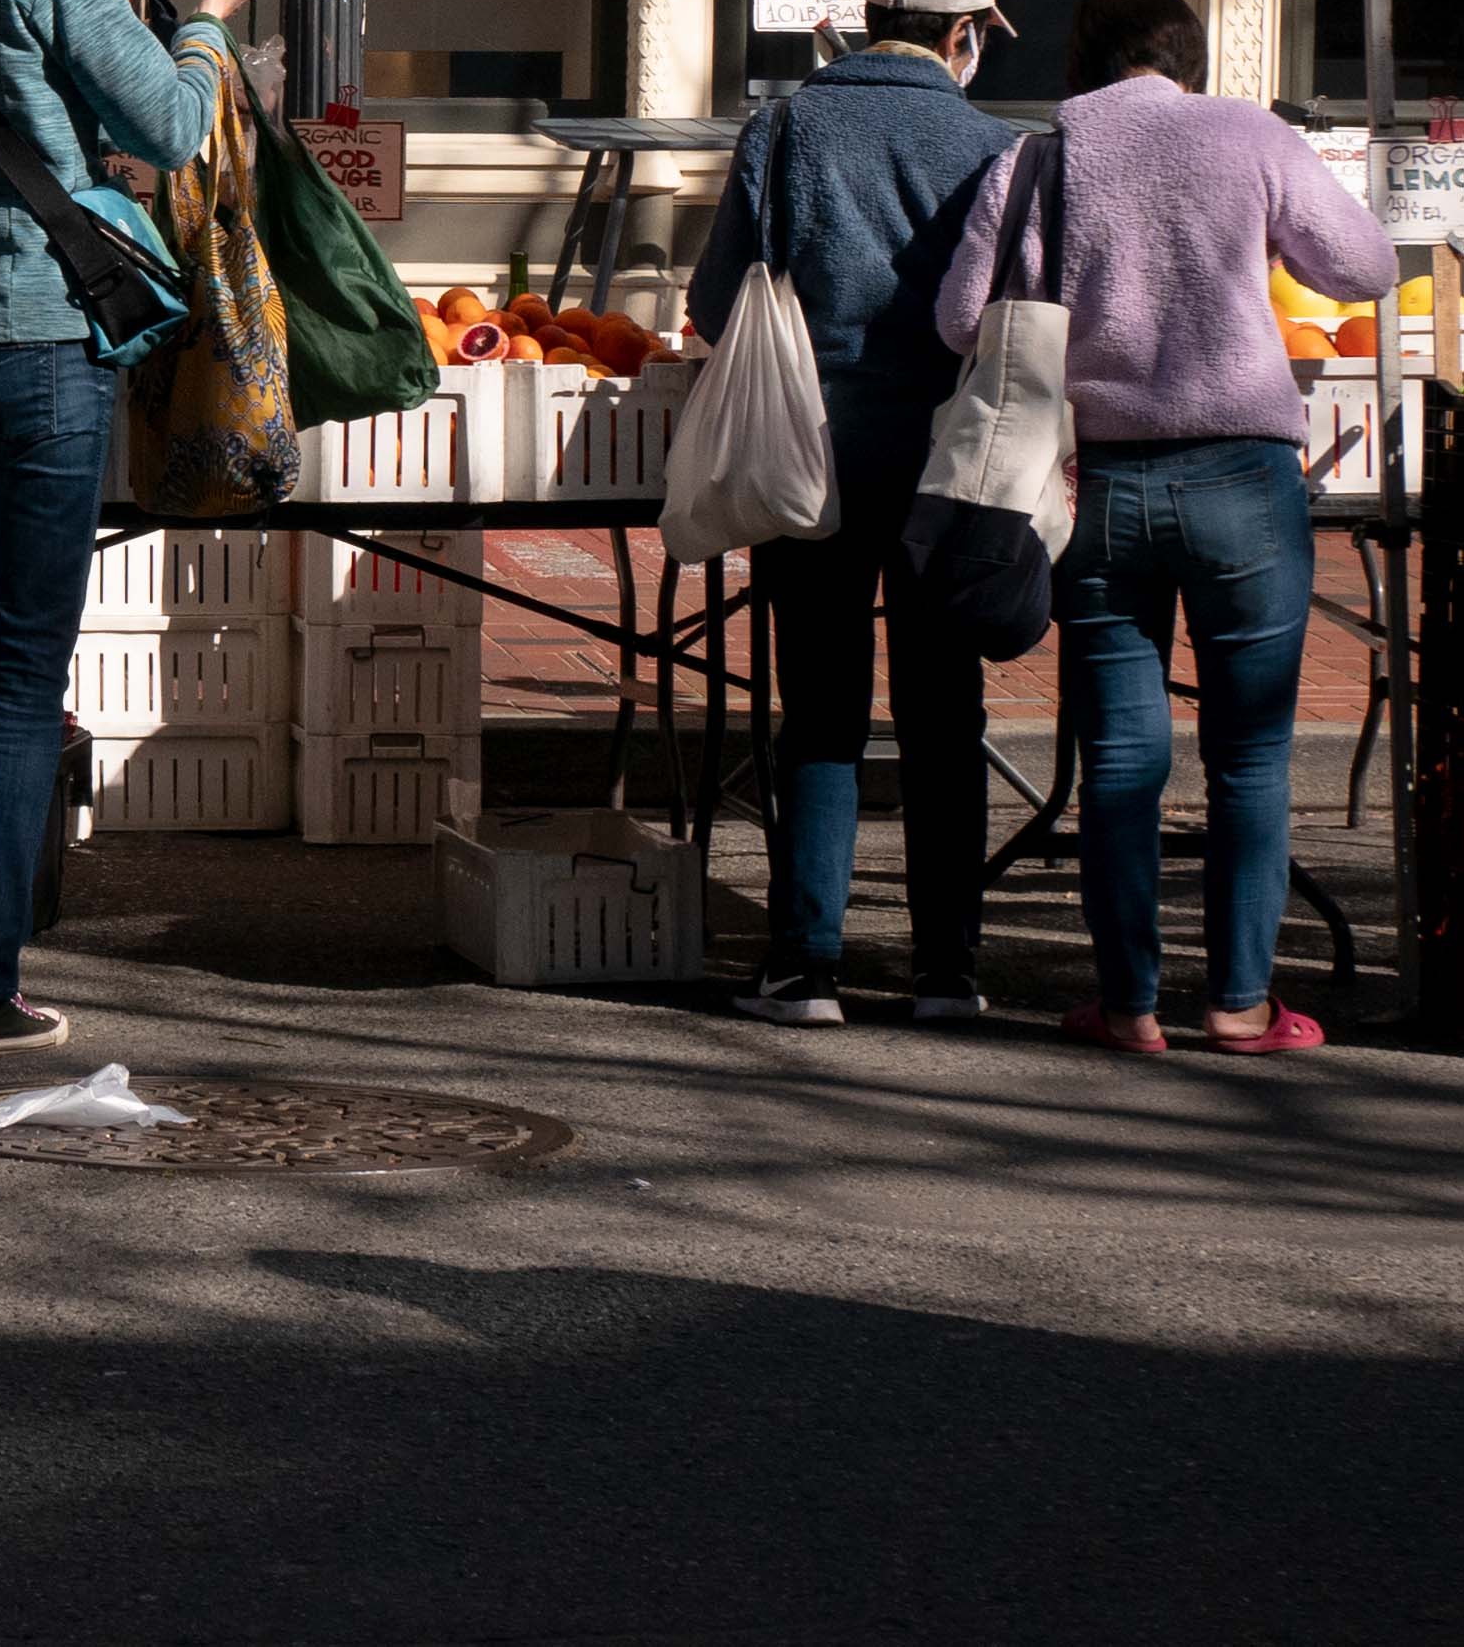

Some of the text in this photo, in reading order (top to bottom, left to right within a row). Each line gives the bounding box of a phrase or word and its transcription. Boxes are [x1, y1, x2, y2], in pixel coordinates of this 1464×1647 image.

[767, 4, 795, 24] 10
[800, 5, 820, 22] LB
[297, 128, 382, 145] RGANIC
[313, 150, 376, 169] OOD
[1387, 144, 1464, 165] ORGA
[328, 169, 382, 188] NGE
[1386, 167, 1464, 191] LEMO
